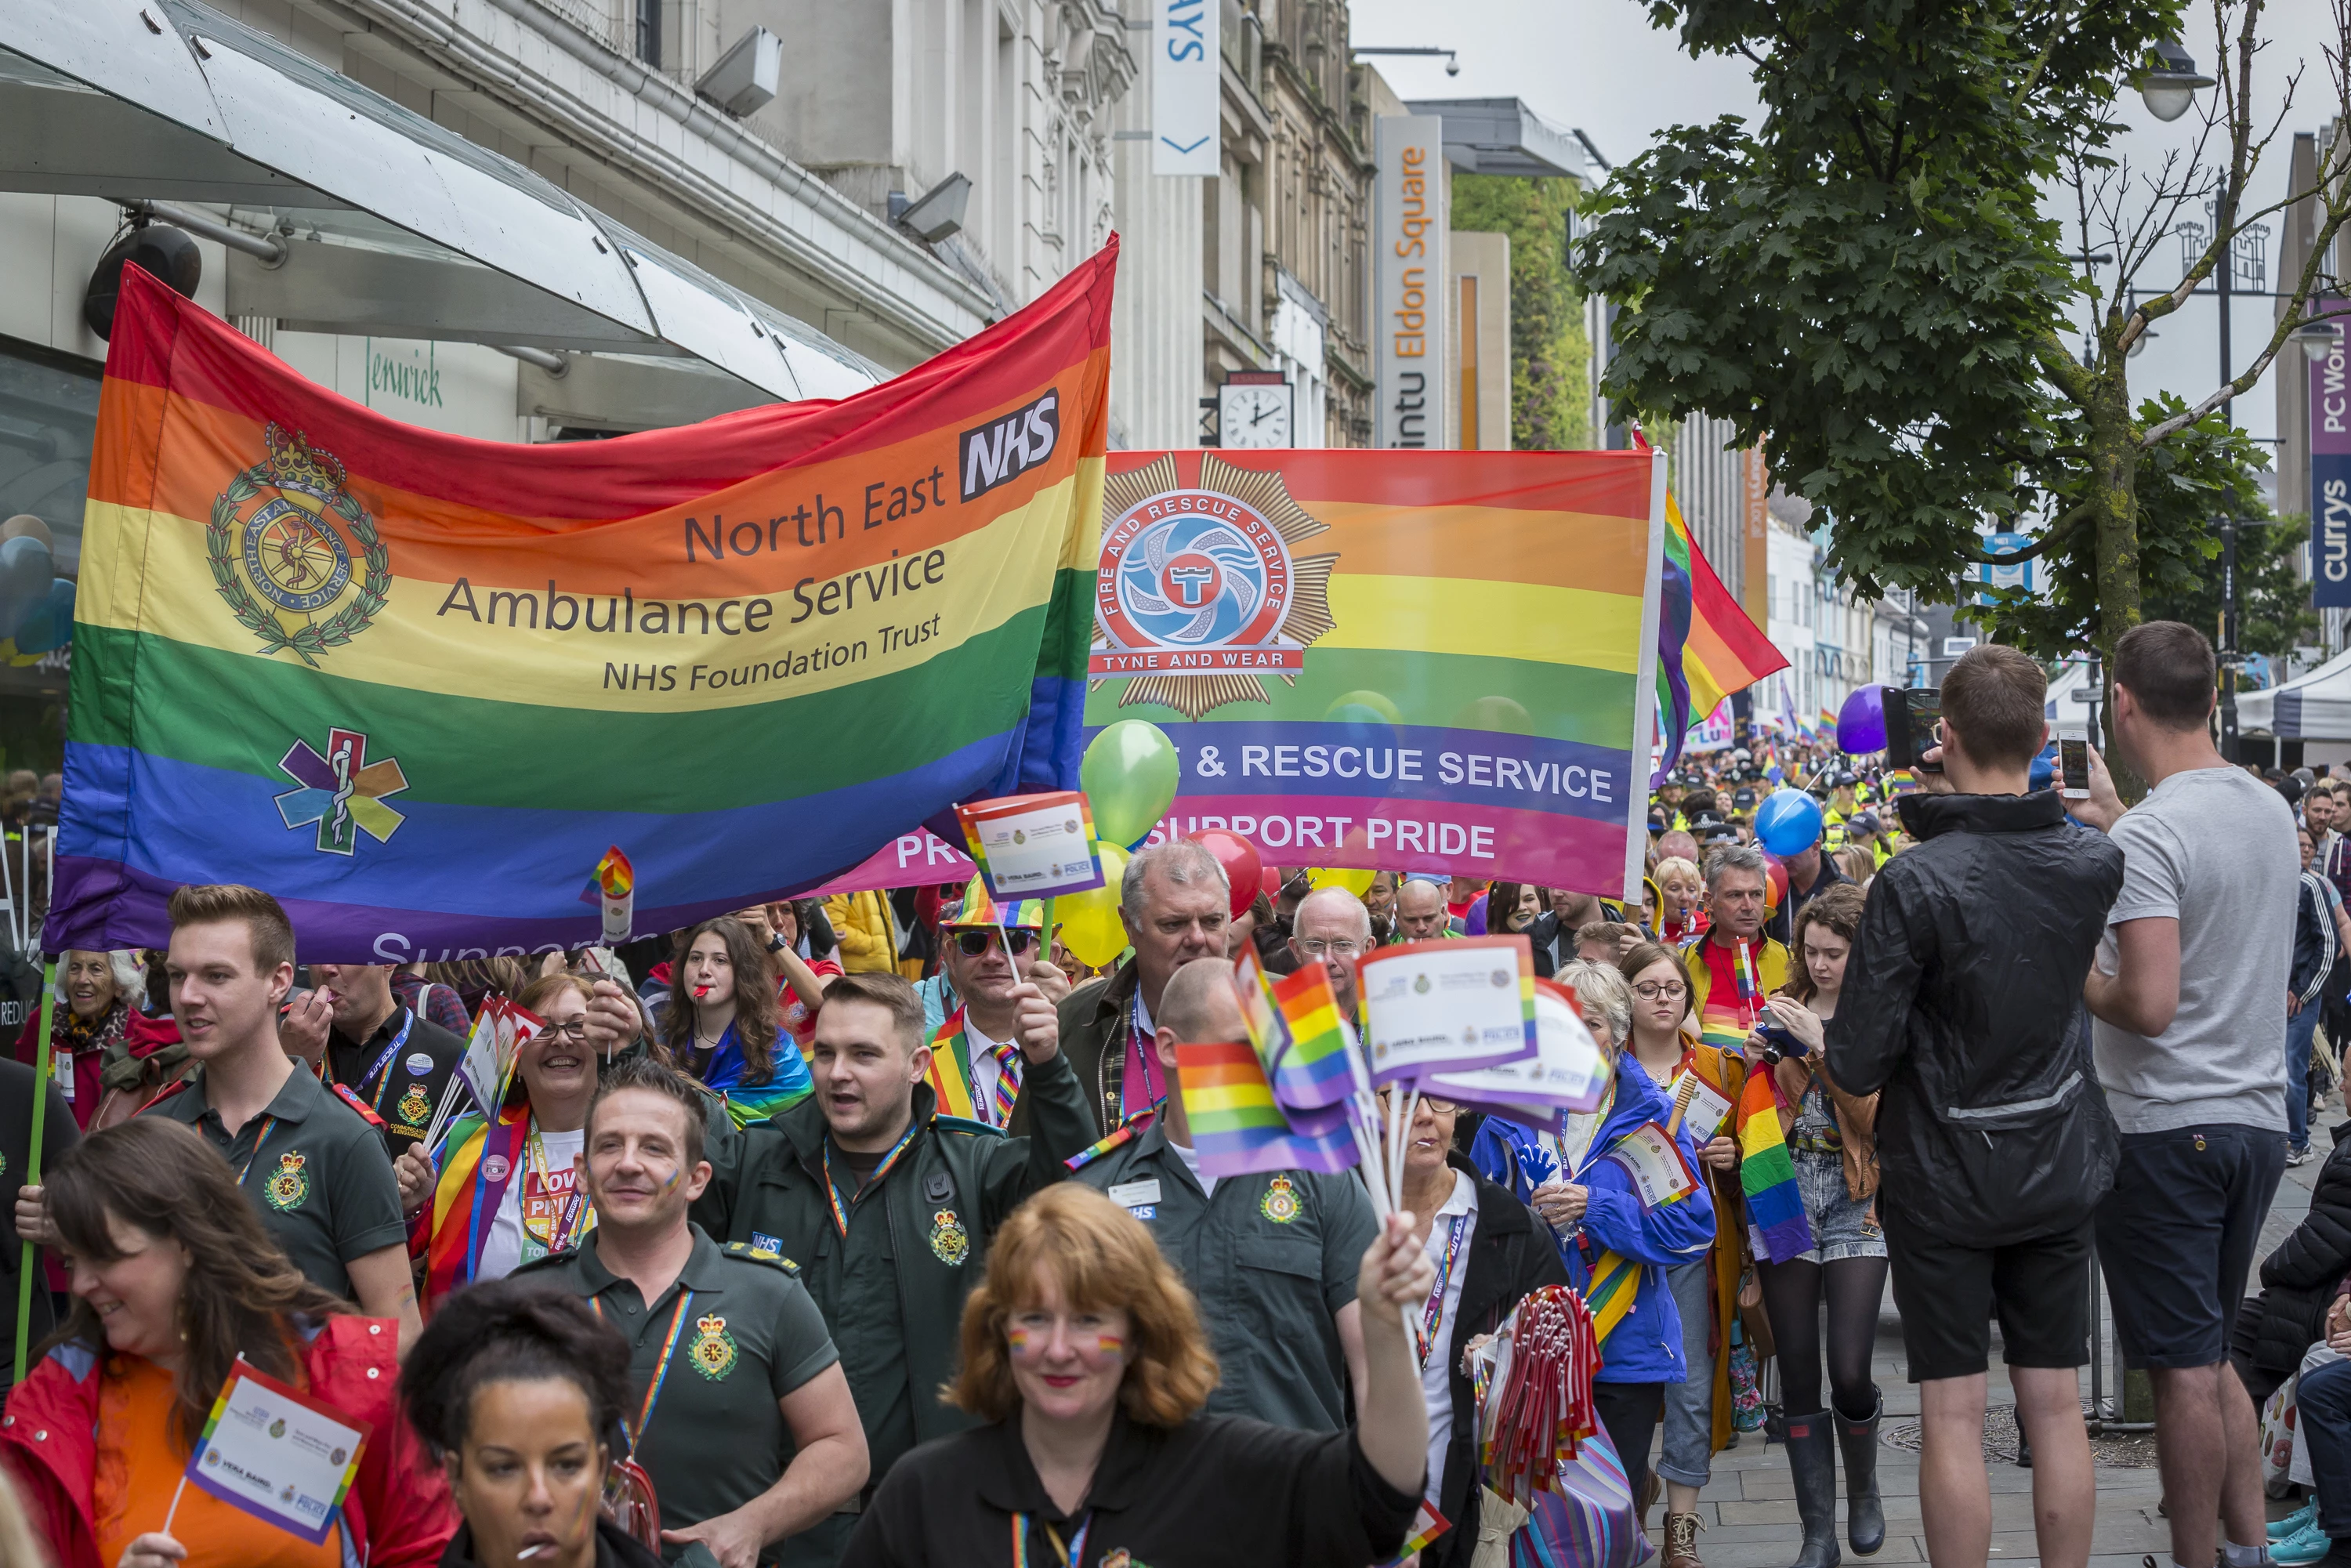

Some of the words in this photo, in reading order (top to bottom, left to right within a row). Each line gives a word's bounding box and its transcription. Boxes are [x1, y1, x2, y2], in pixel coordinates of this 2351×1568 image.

[1396, 146, 1433, 258] Square
[1394, 267, 1426, 358] Eldon
[1391, 371, 1426, 448] intu
[2324, 397, 2346, 433] PC
[685, 493, 844, 563] North
[864, 464, 947, 531] East
[964, 396, 1056, 497] NHS
[1147, 498, 1242, 523] RESCUE
[2324, 479, 2351, 583] currys
[1107, 518, 1142, 559] AND
[300, 560, 349, 608] SERVICE
[1246, 520, 1285, 610] SERVICE
[437, 577, 774, 636] Ambulance
[789, 547, 947, 625] Service
[1100, 567, 1119, 617] FIRE
[603, 661, 676, 693] NHS
[690, 639, 868, 692] Foundation
[877, 611, 942, 656] Trust
[1103, 654, 1159, 671] TYNE
[1169, 653, 1213, 668] AND
[1222, 652, 1284, 667] WEAR
[1196, 745, 1227, 778] &
[1241, 745, 1424, 782] RESCUE
[1437, 751, 1613, 803] SERVICE
[897, 833, 973, 869] PR
[1367, 819, 1495, 860] PRIDE
[1621, 1150, 1631, 1160] VERA
[537, 1171, 576, 1193] LOV
[1646, 1184, 1657, 1204] POLICE
[566, 1195, 581, 1222] Donway
[1128, 1207, 1153, 1219] HS
[752, 1234, 780, 1253] NHS
